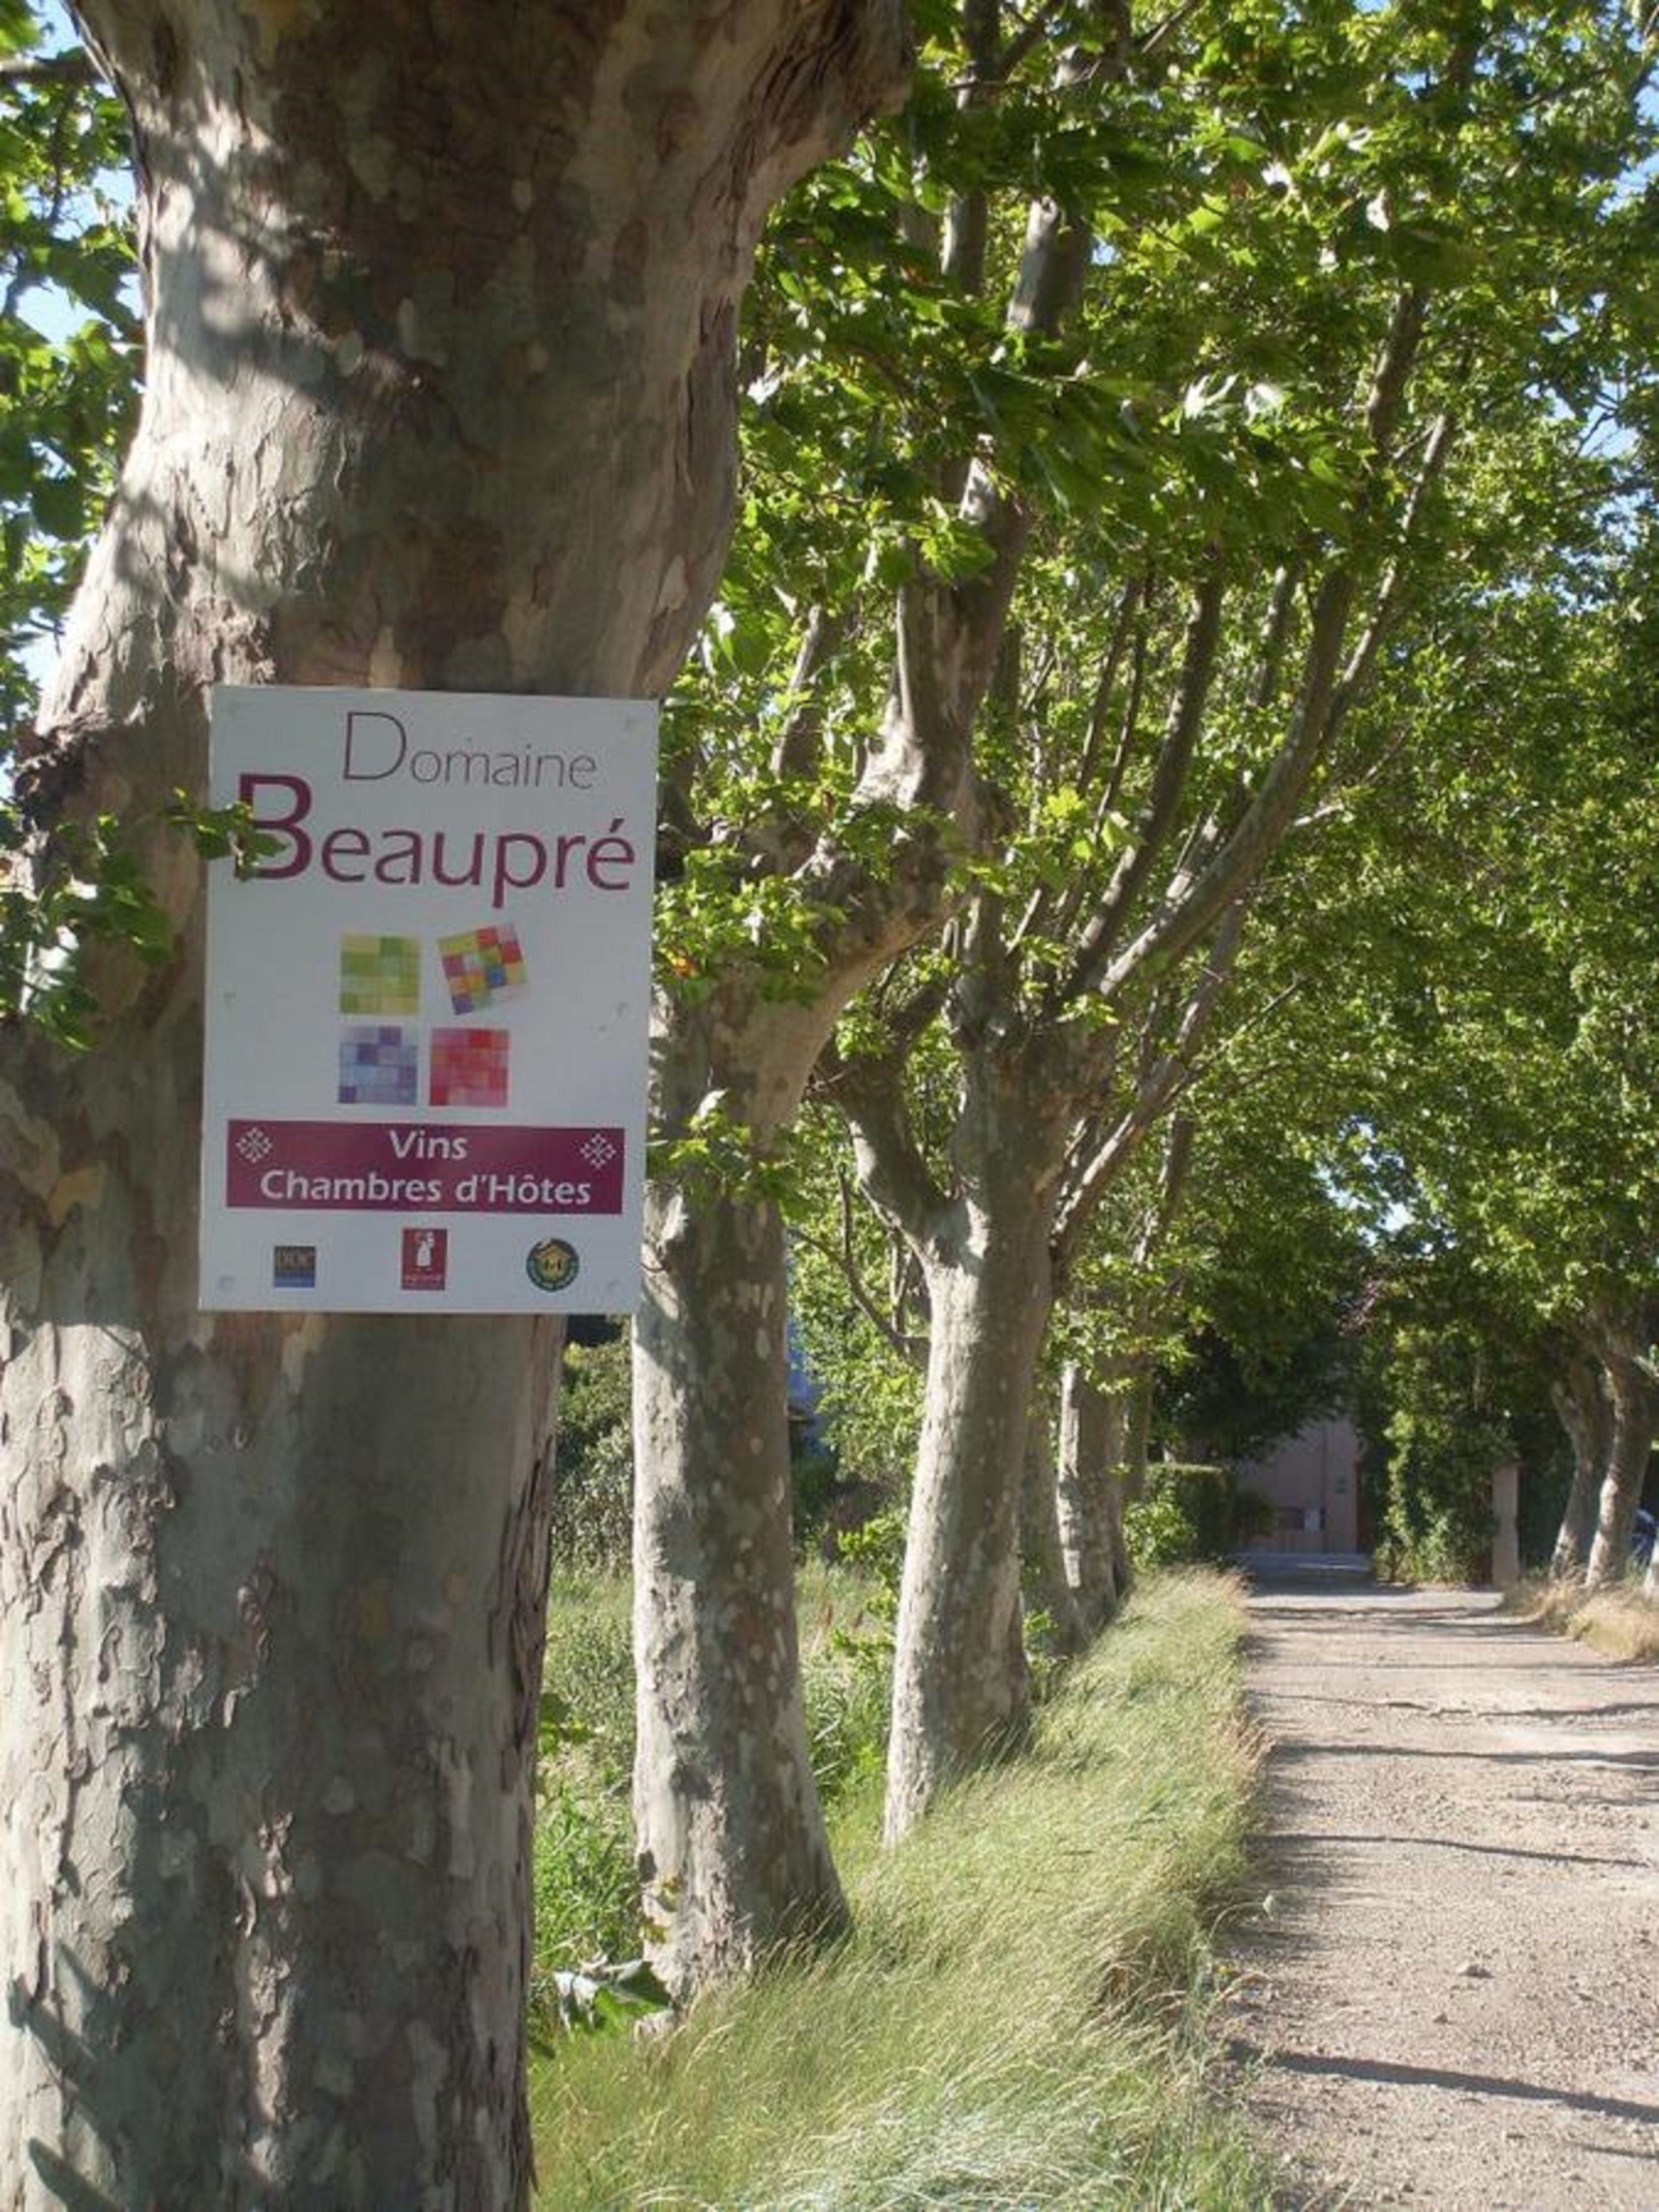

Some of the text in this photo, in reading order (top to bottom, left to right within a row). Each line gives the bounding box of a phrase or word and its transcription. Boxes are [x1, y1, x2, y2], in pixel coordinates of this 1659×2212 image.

[342, 711, 598, 790] Domaine
[233, 772, 637, 909] Beaupré
[389, 1130, 468, 1160] Vins
[259, 1170, 592, 1206] Chambres d'Hôtes
